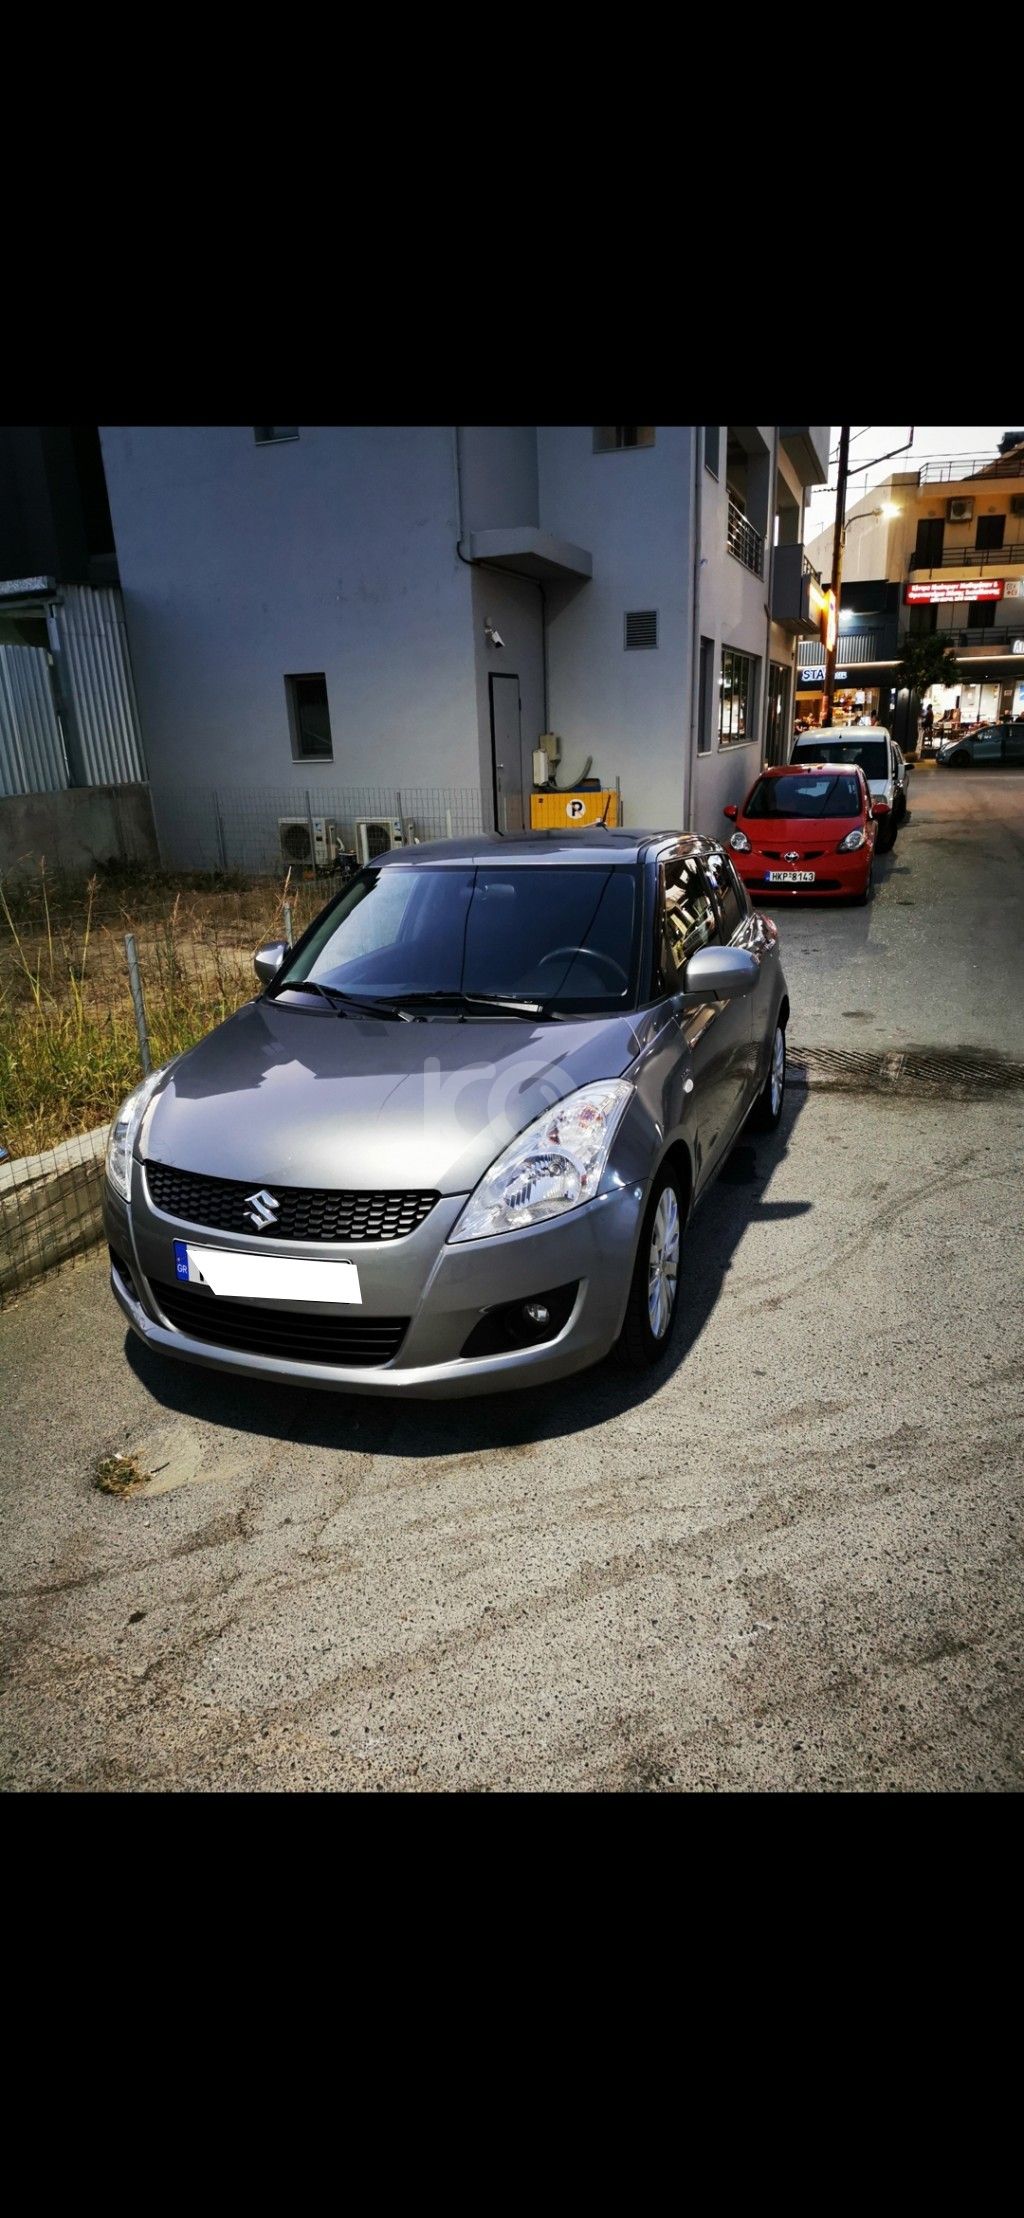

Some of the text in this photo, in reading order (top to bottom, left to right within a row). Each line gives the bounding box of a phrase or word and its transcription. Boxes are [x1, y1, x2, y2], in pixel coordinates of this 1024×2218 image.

[803, 669, 825, 680] STA
[571, 801, 583, 817] P
[791, 872, 814, 881] 8143
[177, 1263, 188, 1274] GR
